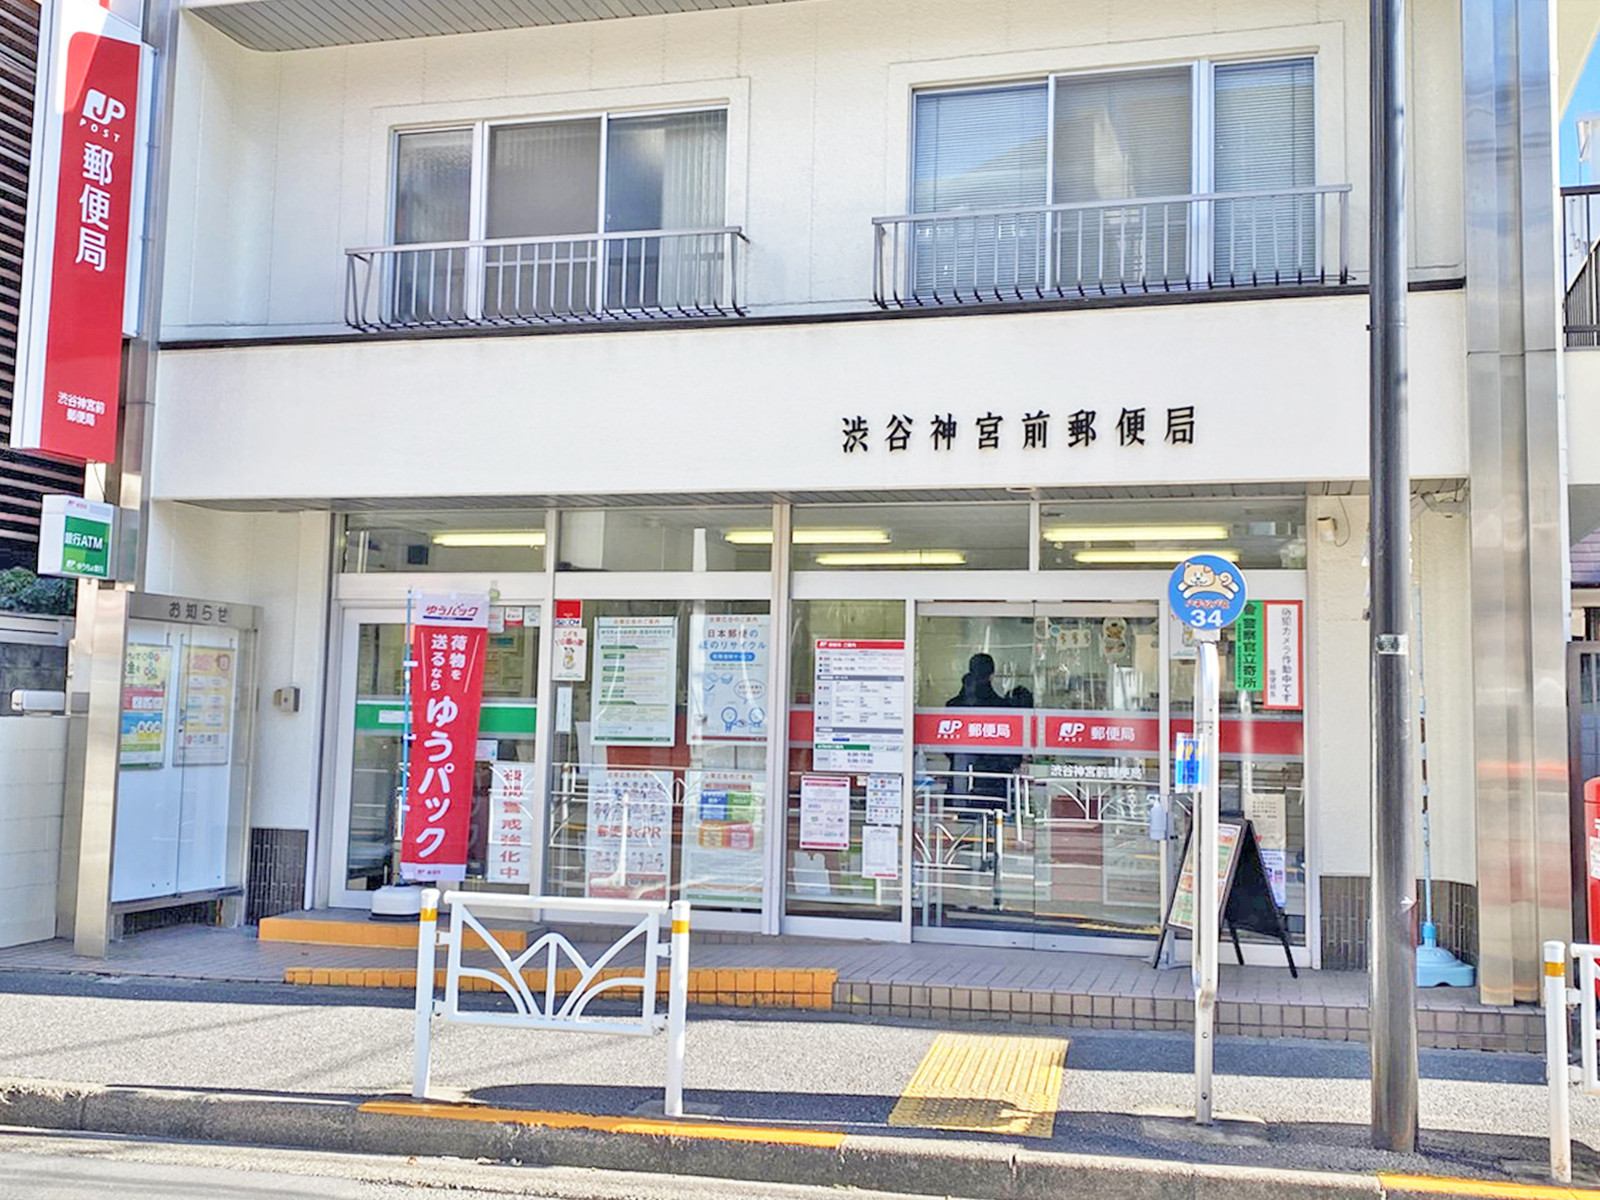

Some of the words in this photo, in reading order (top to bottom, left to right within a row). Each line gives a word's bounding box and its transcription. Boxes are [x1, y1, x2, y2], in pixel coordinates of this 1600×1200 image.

[79, 118, 120, 143] POST
[75, 142, 114, 272] 郵便局
[57, 390, 105, 415] 渋谷神宮前
[66, 408, 96, 427] 郵便局
[841, 405, 1196, 453] 渋谷神宮前郵便局
[169, 602, 229, 623] お知らせ
[425, 603, 479, 617] ゆうパック
[1190, 609, 1224, 627] 34
[430, 633, 448, 691] 送るなら
[449, 634, 468, 681] 荷物を
[1242, 618, 1257, 688] 警察官立寄所
[967, 723, 1011, 739] 郵便局
[1090, 726, 1135, 742] 郵便局
[415, 695, 459, 858] ゆうパック
[1050, 763, 1142, 780] 渋谷神宮前郵便局
